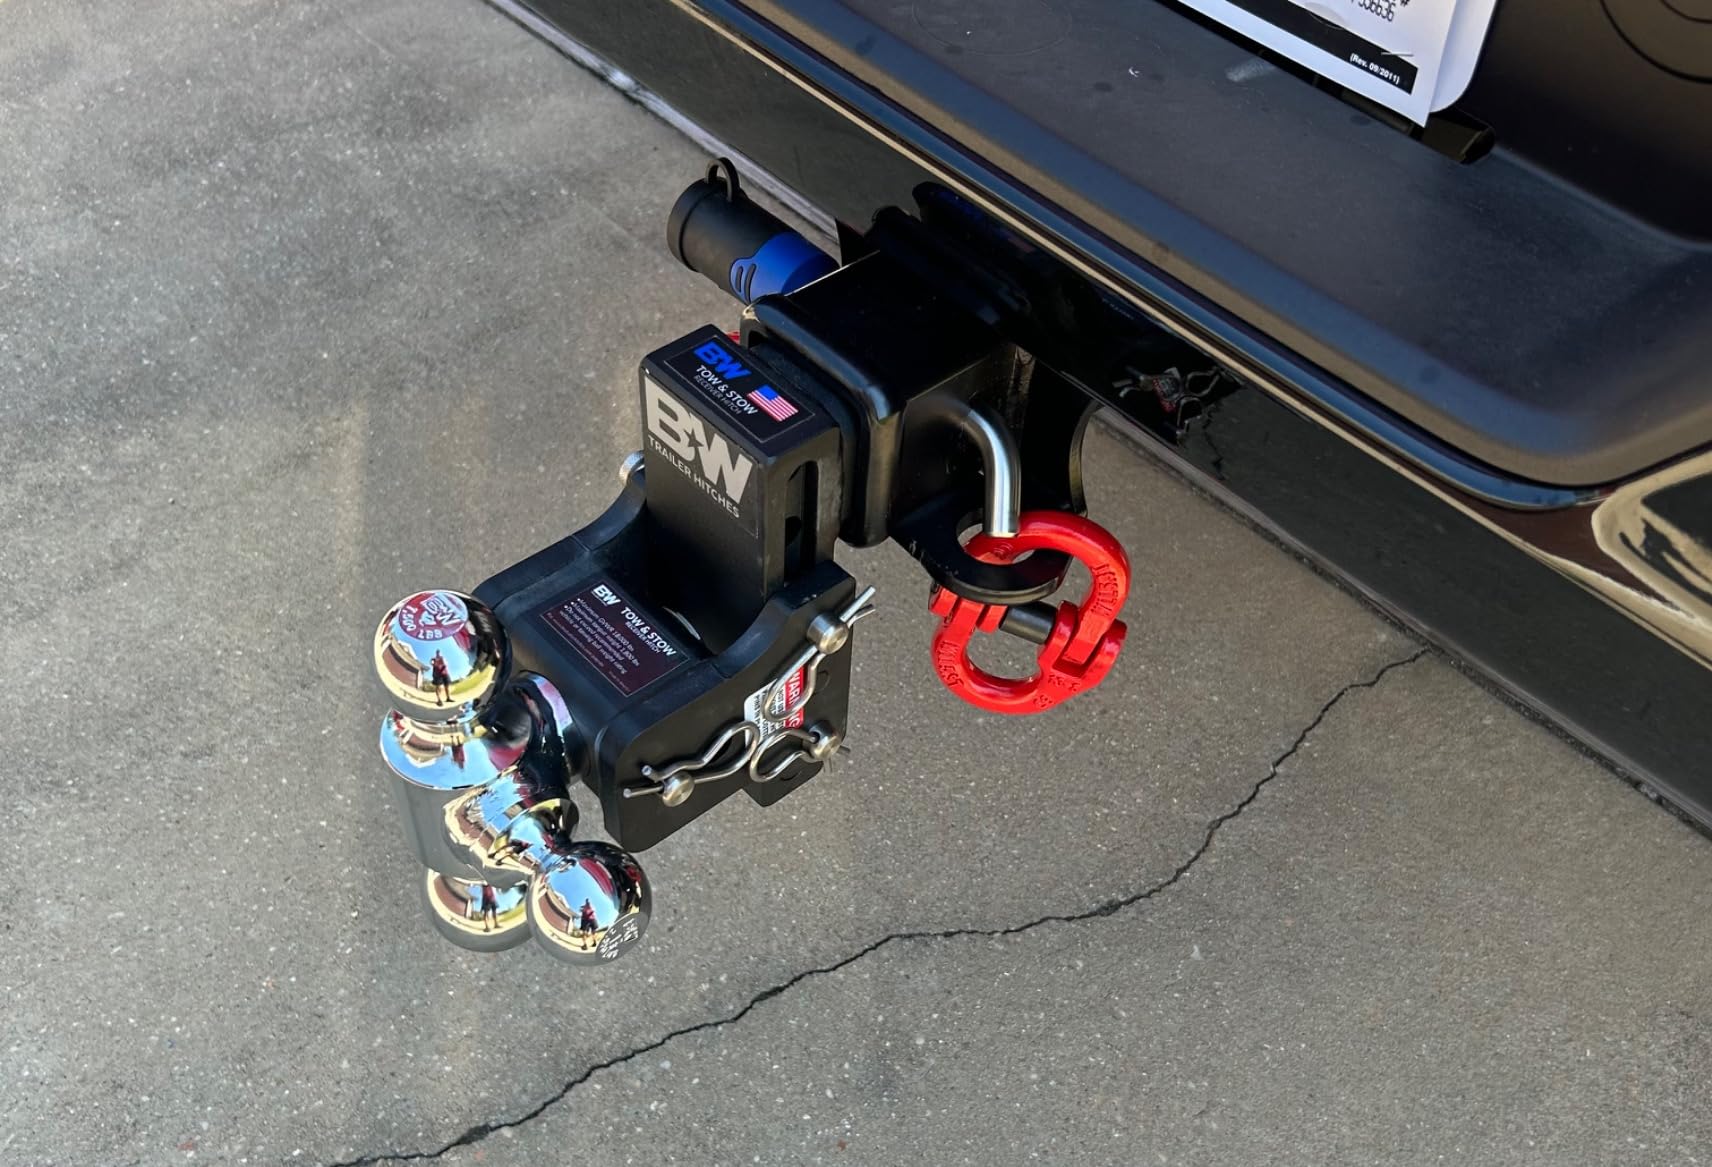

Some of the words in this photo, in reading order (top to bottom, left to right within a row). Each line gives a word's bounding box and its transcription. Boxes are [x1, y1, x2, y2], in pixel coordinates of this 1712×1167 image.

[1349, 53, 1368, 67] (Rev.
[694, 365, 722, 385] TOW
[716, 383, 730, 392] &
[724, 390, 758, 415] STOW
[648, 435, 691, 478] TRAILER
[694, 474, 739, 518] HITCHES
[618, 606, 644, 627] TOW
[639, 625, 651, 634] &
[646, 631, 676, 656] STOW
